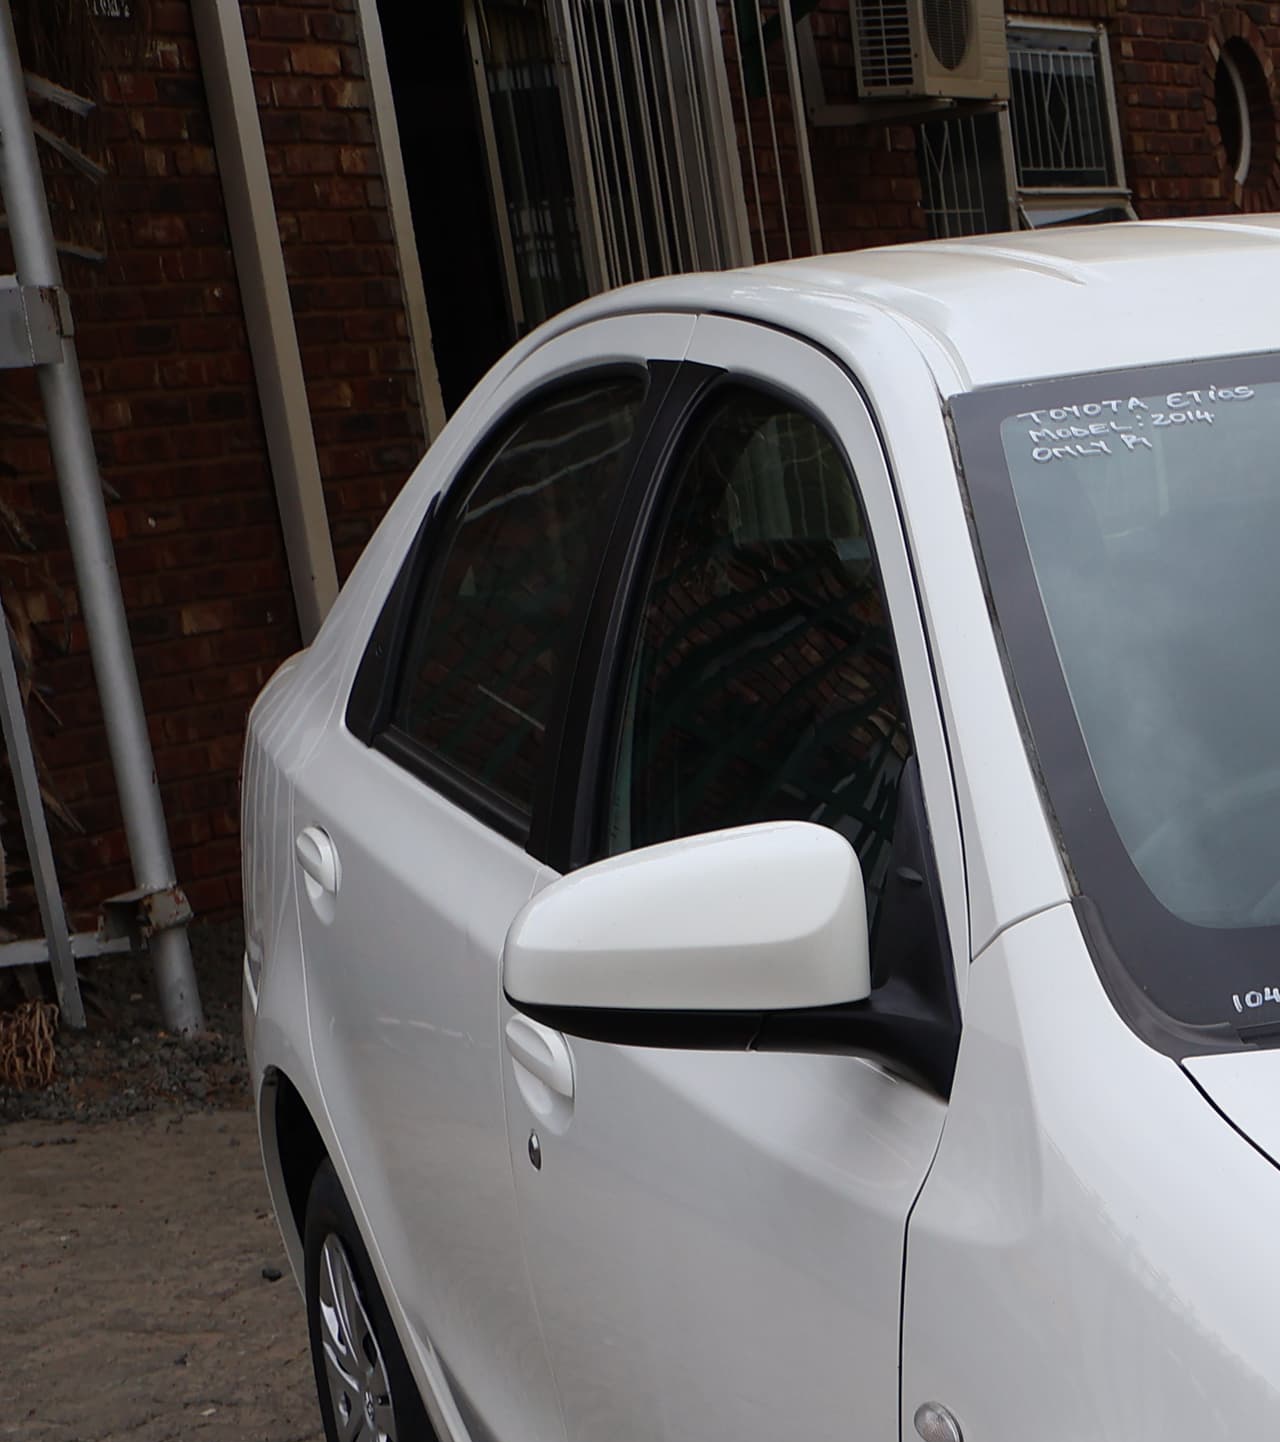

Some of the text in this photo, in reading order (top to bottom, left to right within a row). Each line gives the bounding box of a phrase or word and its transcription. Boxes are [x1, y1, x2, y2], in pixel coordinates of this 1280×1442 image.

[1016, 397, 1149, 424] TOYOTA
[1151, 409, 1215, 428] 2014
[1031, 440, 1112, 462] ONLY
